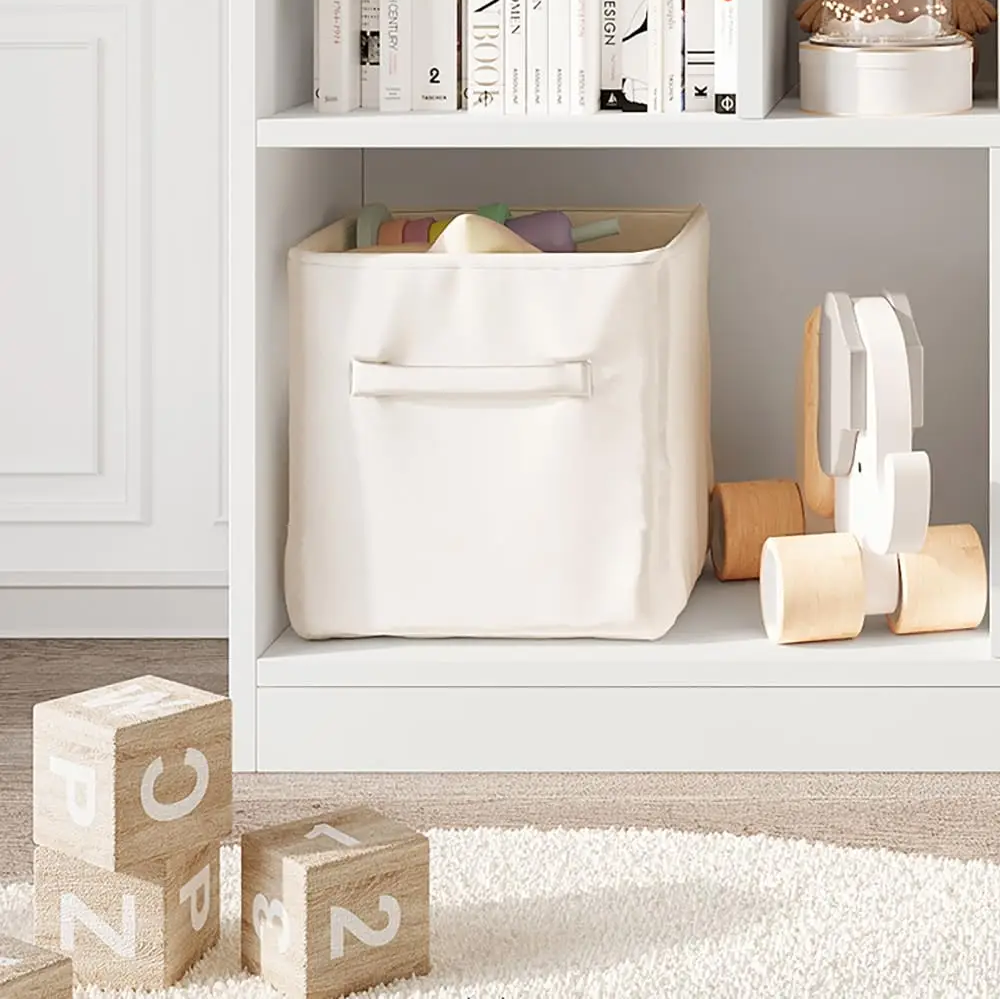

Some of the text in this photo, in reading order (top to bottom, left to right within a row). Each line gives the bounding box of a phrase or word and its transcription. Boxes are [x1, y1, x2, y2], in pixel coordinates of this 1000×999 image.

[387, 4, 399, 51] CENTURY
[429, 68, 441, 84] 2
[49, 755, 97, 827] P
[140, 747, 209, 822] C
[179, 863, 211, 931] P
[330, 895, 401, 960] 2
